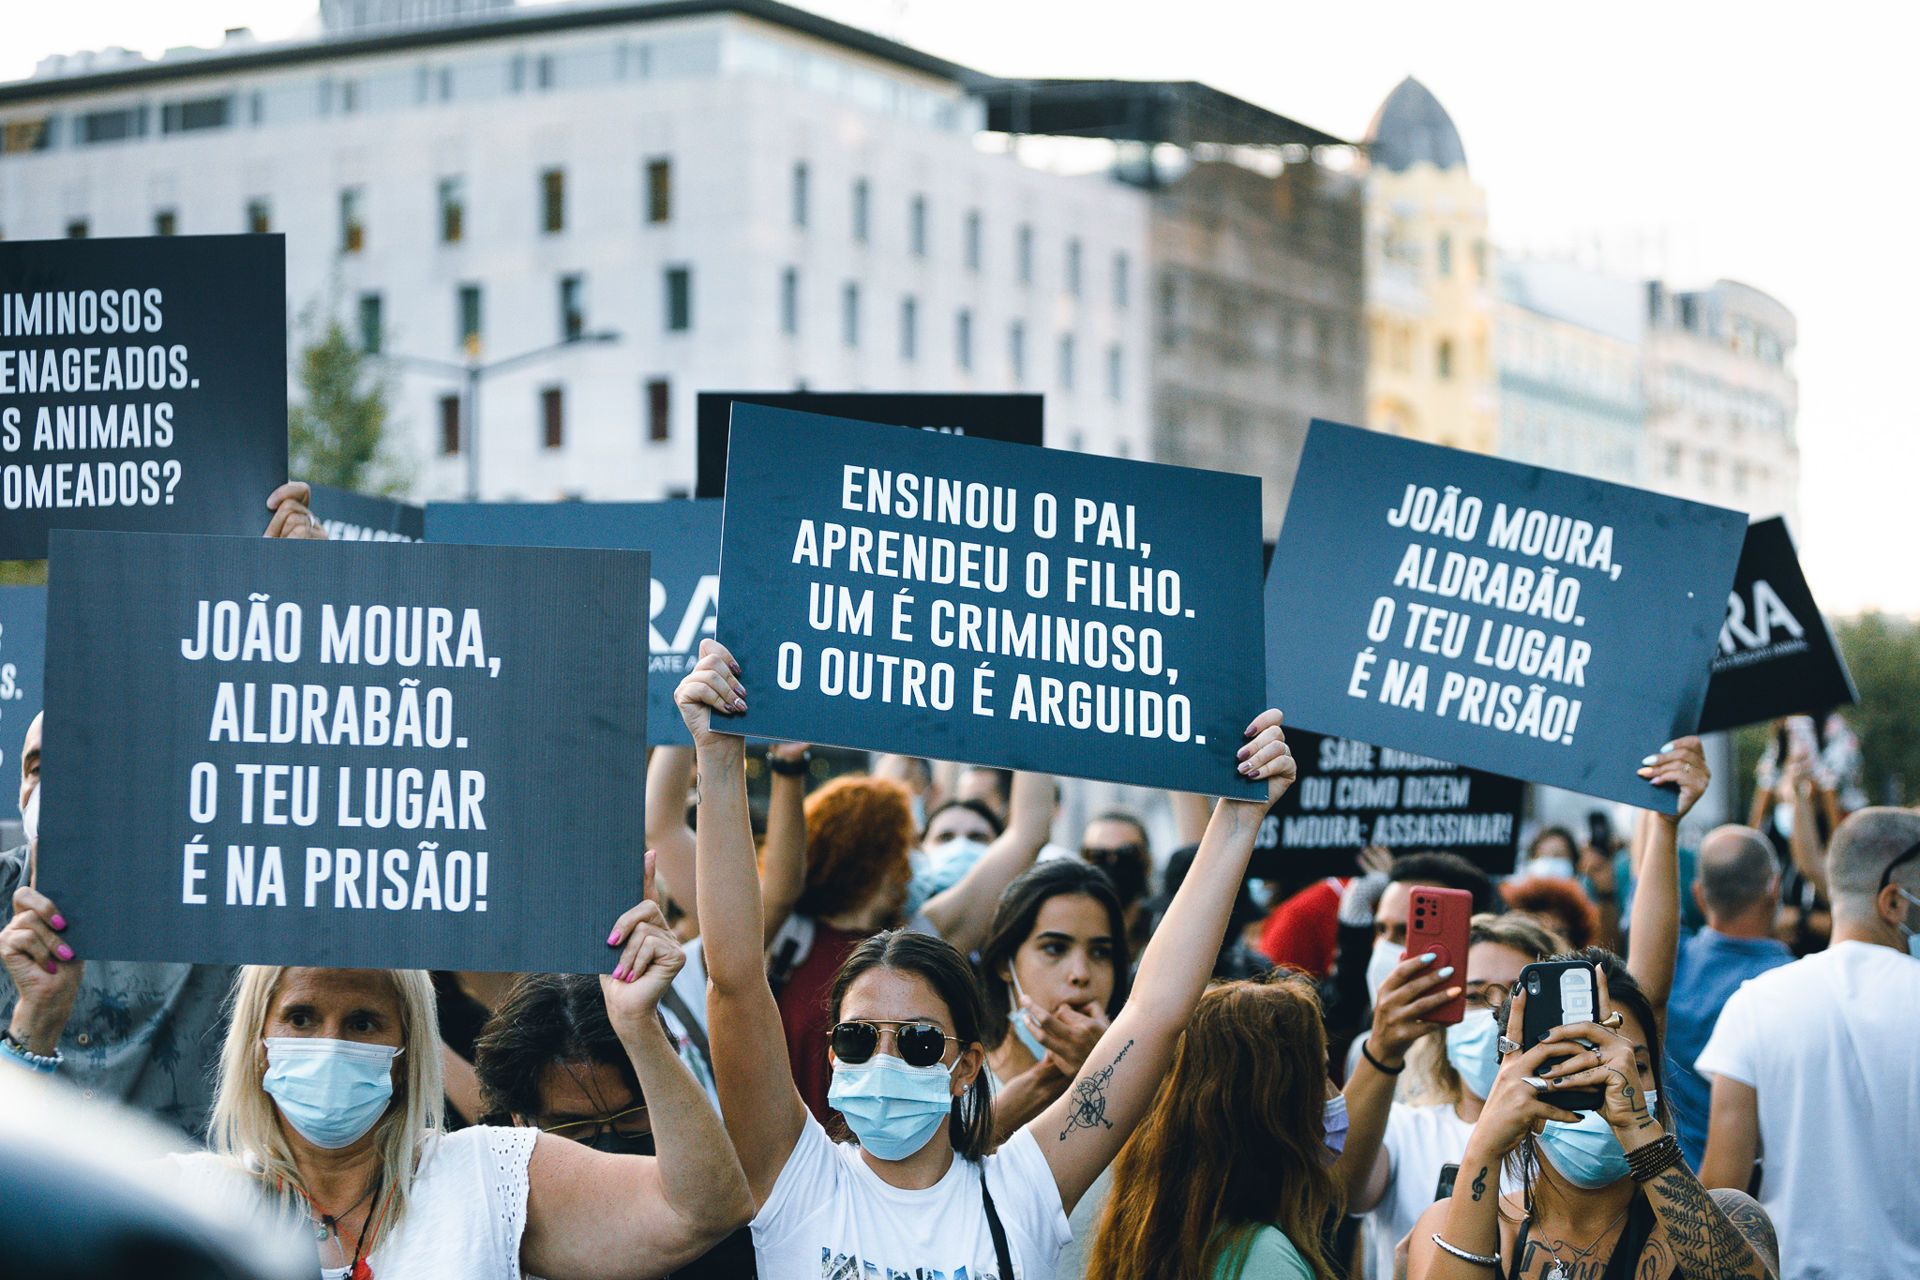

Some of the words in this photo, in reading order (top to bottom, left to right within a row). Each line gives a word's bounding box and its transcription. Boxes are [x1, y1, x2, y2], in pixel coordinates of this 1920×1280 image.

[0, 288, 163, 337] IMINOSOS
[33, 402, 174, 451] ANIMAIS
[0, 459, 182, 510] OMEADOS?
[841, 464, 1017, 533] ENSINOU
[1033, 492, 1057, 539] O
[1074, 497, 1151, 559] PAI,
[791, 518, 1009, 593] APRENDEU
[1025, 551, 1049, 599] O
[1066, 556, 1196, 619] FILHO.
[1387, 482, 1483, 542] JOÃO
[1486, 502, 1623, 581] MOURA,
[1393, 543, 1586, 627] ALDRABÃO.
[180, 592, 303, 664] JOÃO
[320, 603, 501, 678] MOURA,
[808, 581, 874, 637] UM
[891, 587, 915, 643] É
[930, 599, 1178, 686] CRIMINOSO,
[1366, 596, 1396, 643] O
[1403, 602, 1471, 659] TEU
[1473, 619, 1592, 688] LUGAR
[208, 677, 469, 749] ALDRABÃO.
[776, 641, 803, 691] O
[819, 647, 955, 711] OUTRO
[972, 660, 995, 717] É
[1009, 673, 1206, 745] ARGUIDO.
[1347, 646, 1378, 699] É
[1378, 658, 1429, 712] NA
[1436, 671, 1582, 746] PRISÃO!
[189, 761, 218, 824] O
[235, 763, 320, 827] TEU
[337, 766, 487, 831] LUGAR
[1334, 775, 1399, 810] COMO
[1401, 775, 1472, 810] DIZEM
[182, 834, 209, 905] É
[225, 844, 287, 907] NA
[304, 840, 489, 912] PRISÃO!
